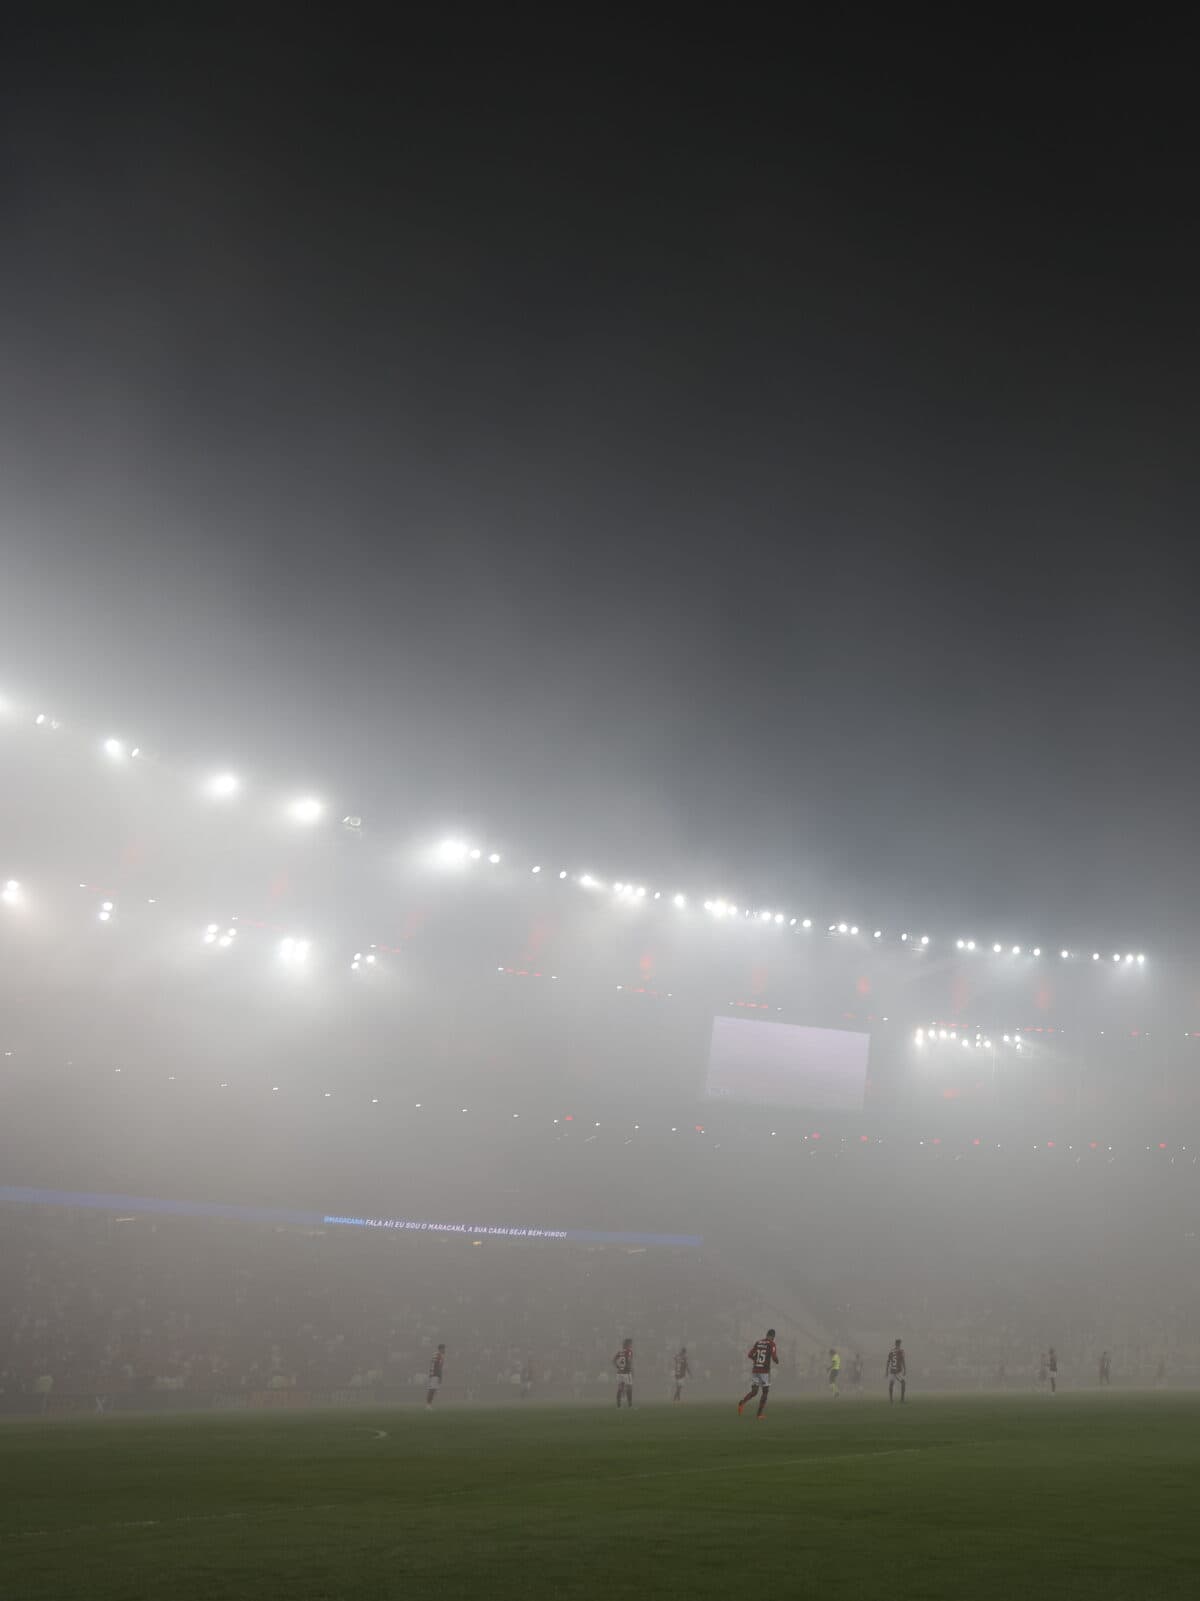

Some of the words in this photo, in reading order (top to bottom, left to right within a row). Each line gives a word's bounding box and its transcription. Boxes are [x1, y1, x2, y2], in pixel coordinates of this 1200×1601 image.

[366, 1219, 382, 1227] FALA
[406, 1222, 421, 1230] SOU
[756, 1349, 766, 1363] 15
